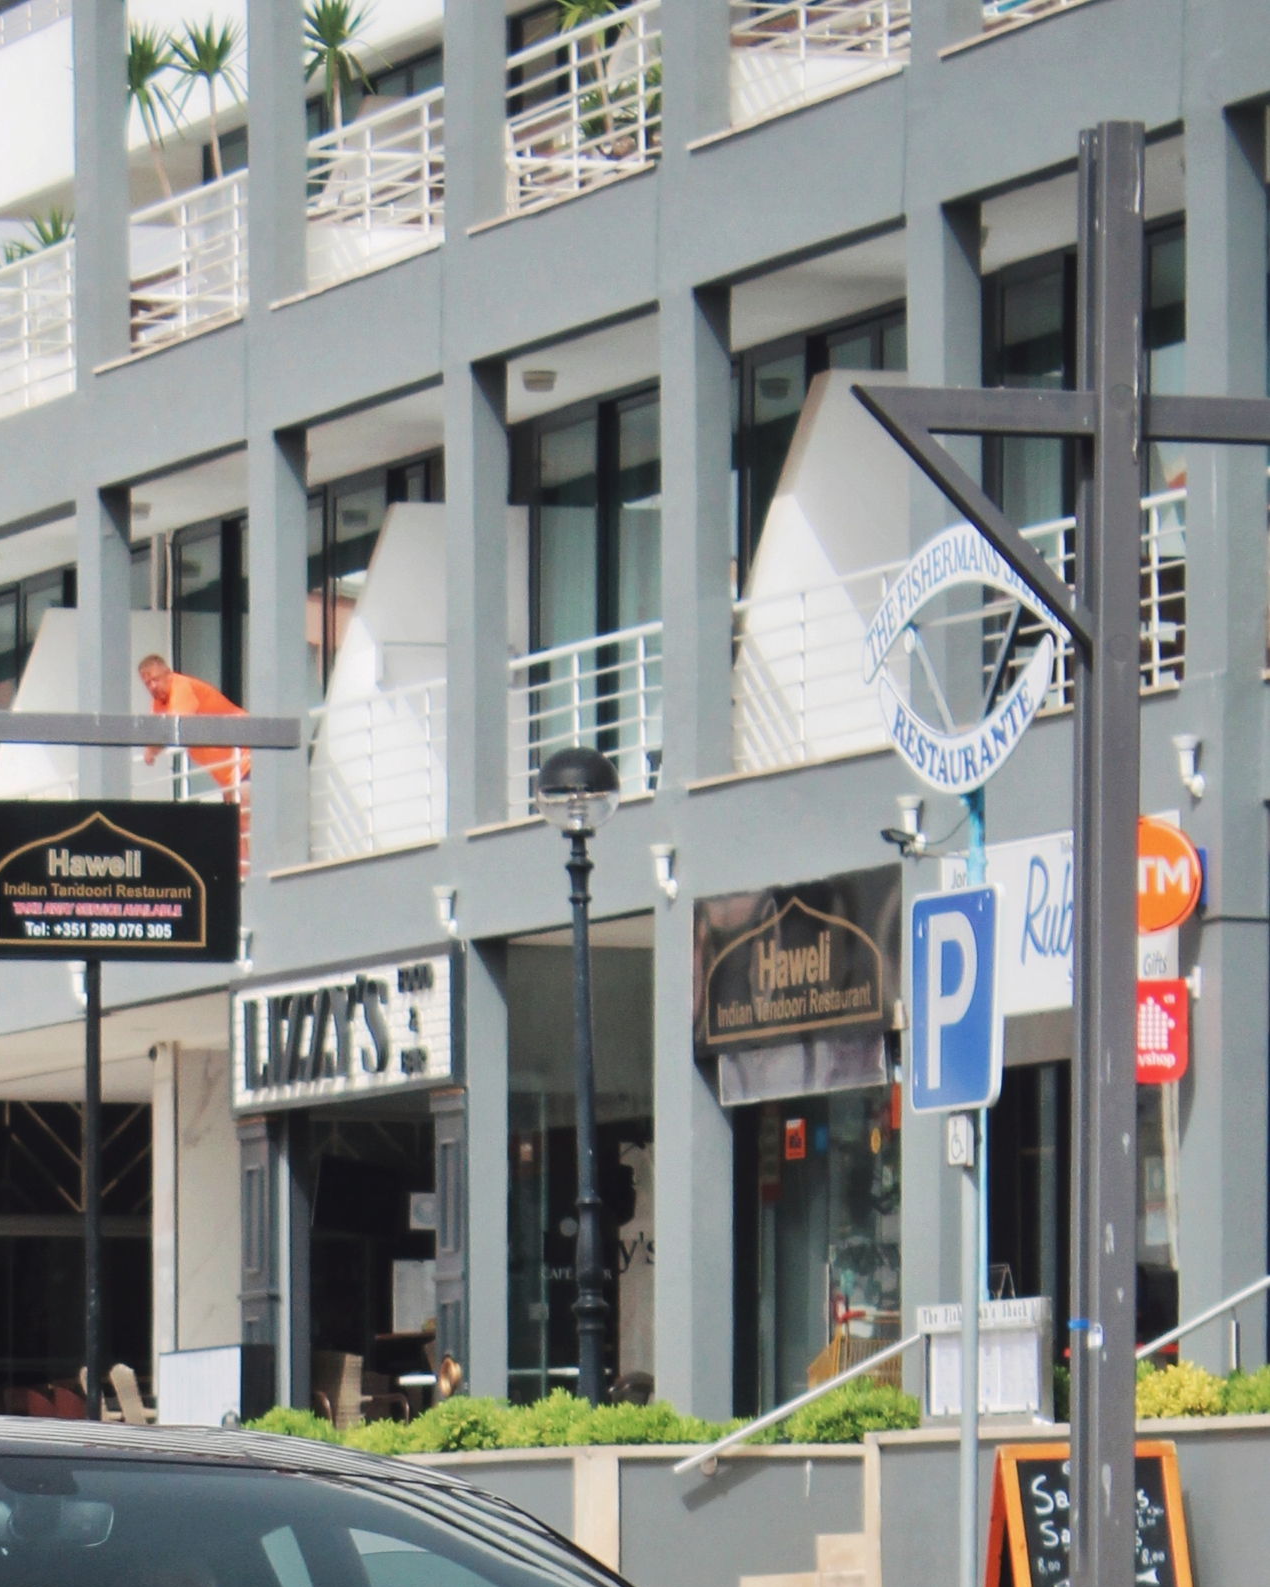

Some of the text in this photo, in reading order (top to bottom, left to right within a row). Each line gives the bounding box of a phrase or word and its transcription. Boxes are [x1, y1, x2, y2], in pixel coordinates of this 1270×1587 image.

[867, 603, 899, 666] THE
[892, 679, 1035, 785] RESTAURANTE
[48, 848, 142, 878] Haweli
[1138, 856, 1191, 895] TM
[4, 882, 191, 899] Indian Tandoori Restaurant
[24, 921, 172, 939] Tel: +351 289 076 305
[757, 930, 831, 991] Haweli
[717, 981, 872, 1028] Indian Tandoori Restaurant
[926, 911, 978, 1090] P
[1138, 1051, 1176, 1069] yshop
